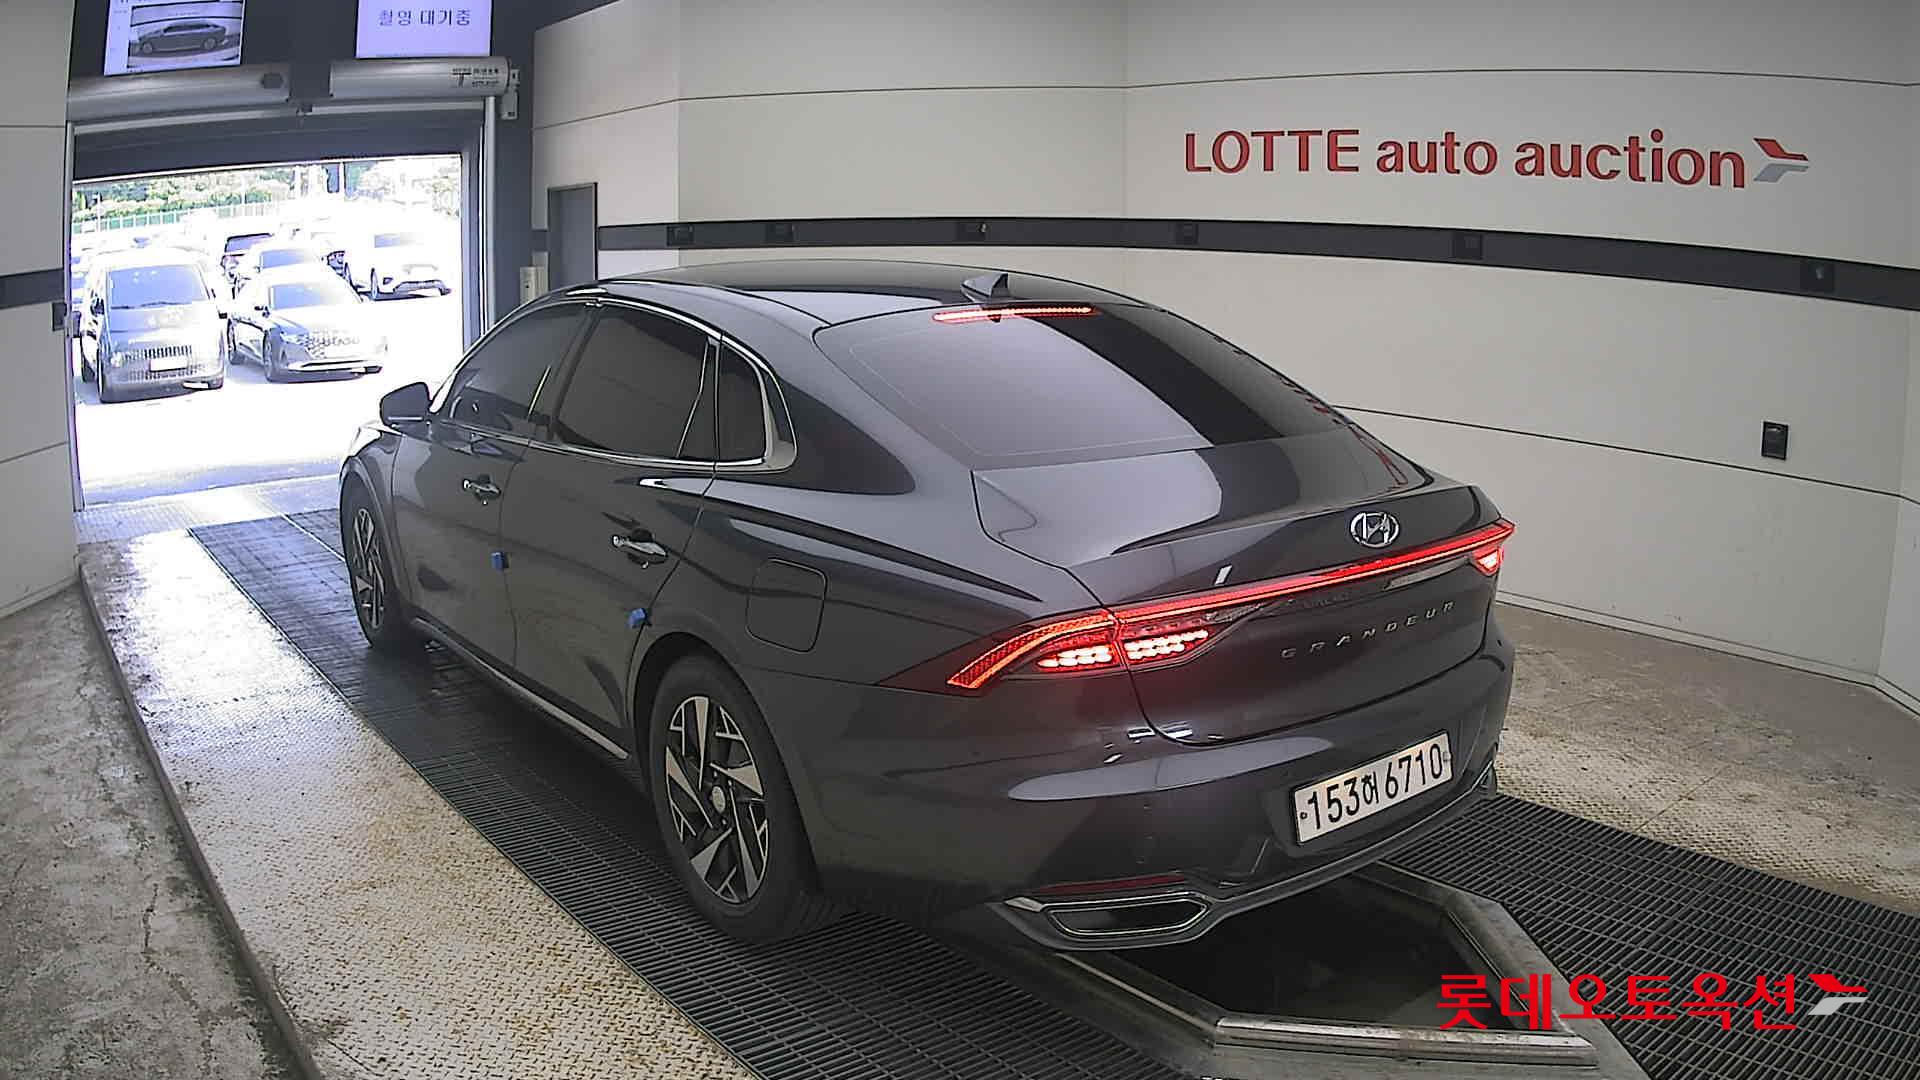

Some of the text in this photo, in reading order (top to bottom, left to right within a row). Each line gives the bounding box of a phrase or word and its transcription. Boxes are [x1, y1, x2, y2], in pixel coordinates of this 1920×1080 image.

[420, 9, 471, 26] 대기중
[1185, 129, 1745, 189] LOTTE auto auction
[1281, 601, 1455, 660] GRANDEUR
[1306, 743, 1442, 831] 153허6710
